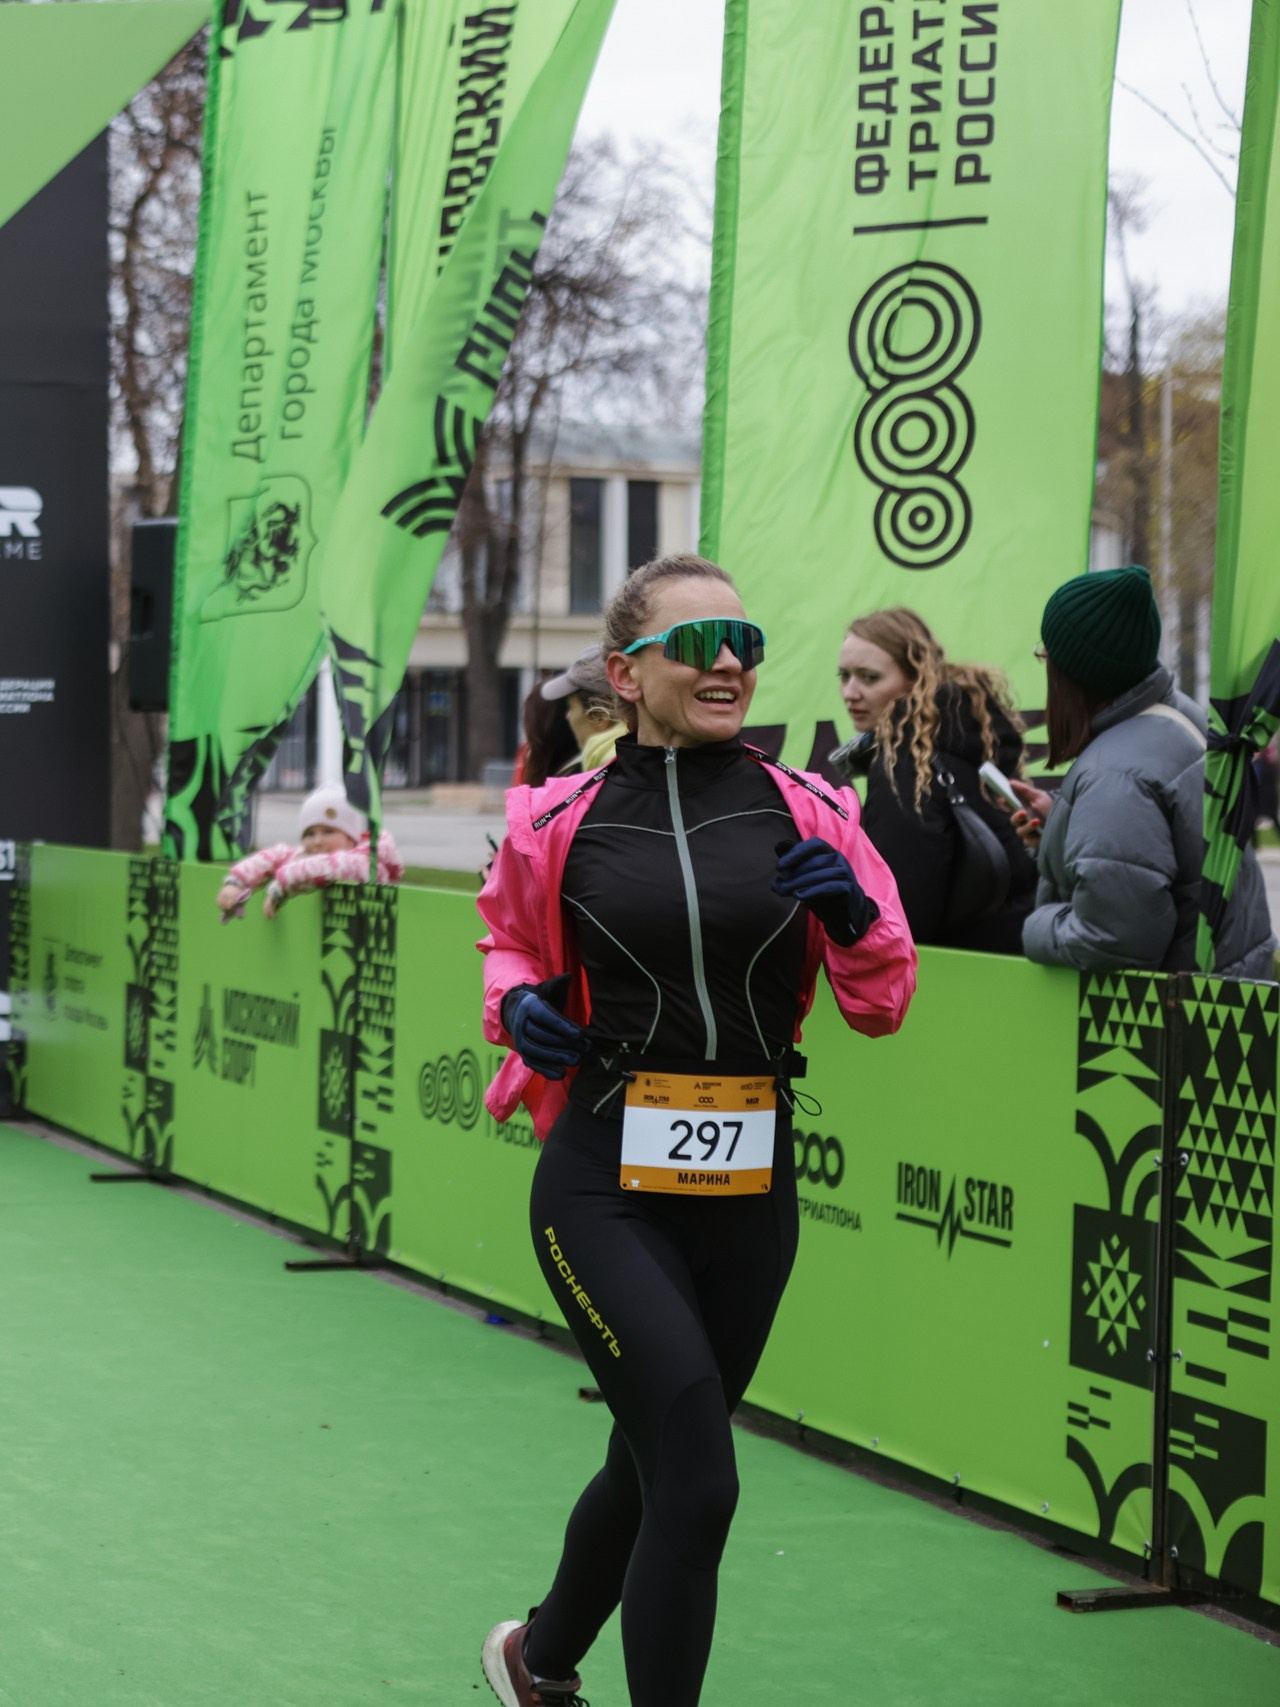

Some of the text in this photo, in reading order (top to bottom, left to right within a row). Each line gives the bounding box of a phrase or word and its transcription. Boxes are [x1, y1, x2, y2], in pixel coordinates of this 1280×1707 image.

[854, 0, 899, 195] ФЕДЕР
[230, 190, 274, 464] Департамент
[280, 298, 324, 440] города
[593, 771, 606, 782] RUN
[565, 793, 578, 805] RUN
[533, 817, 547, 829] RUN
[668, 1119, 744, 1162] 297
[677, 1172, 731, 1186] МАРИНА
[898, 1161, 1015, 1231] IRON STAR
[799, 1197, 863, 1232] ТРИАТЛОНА
[544, 1226, 621, 1358] РОСНЕФТЬ
